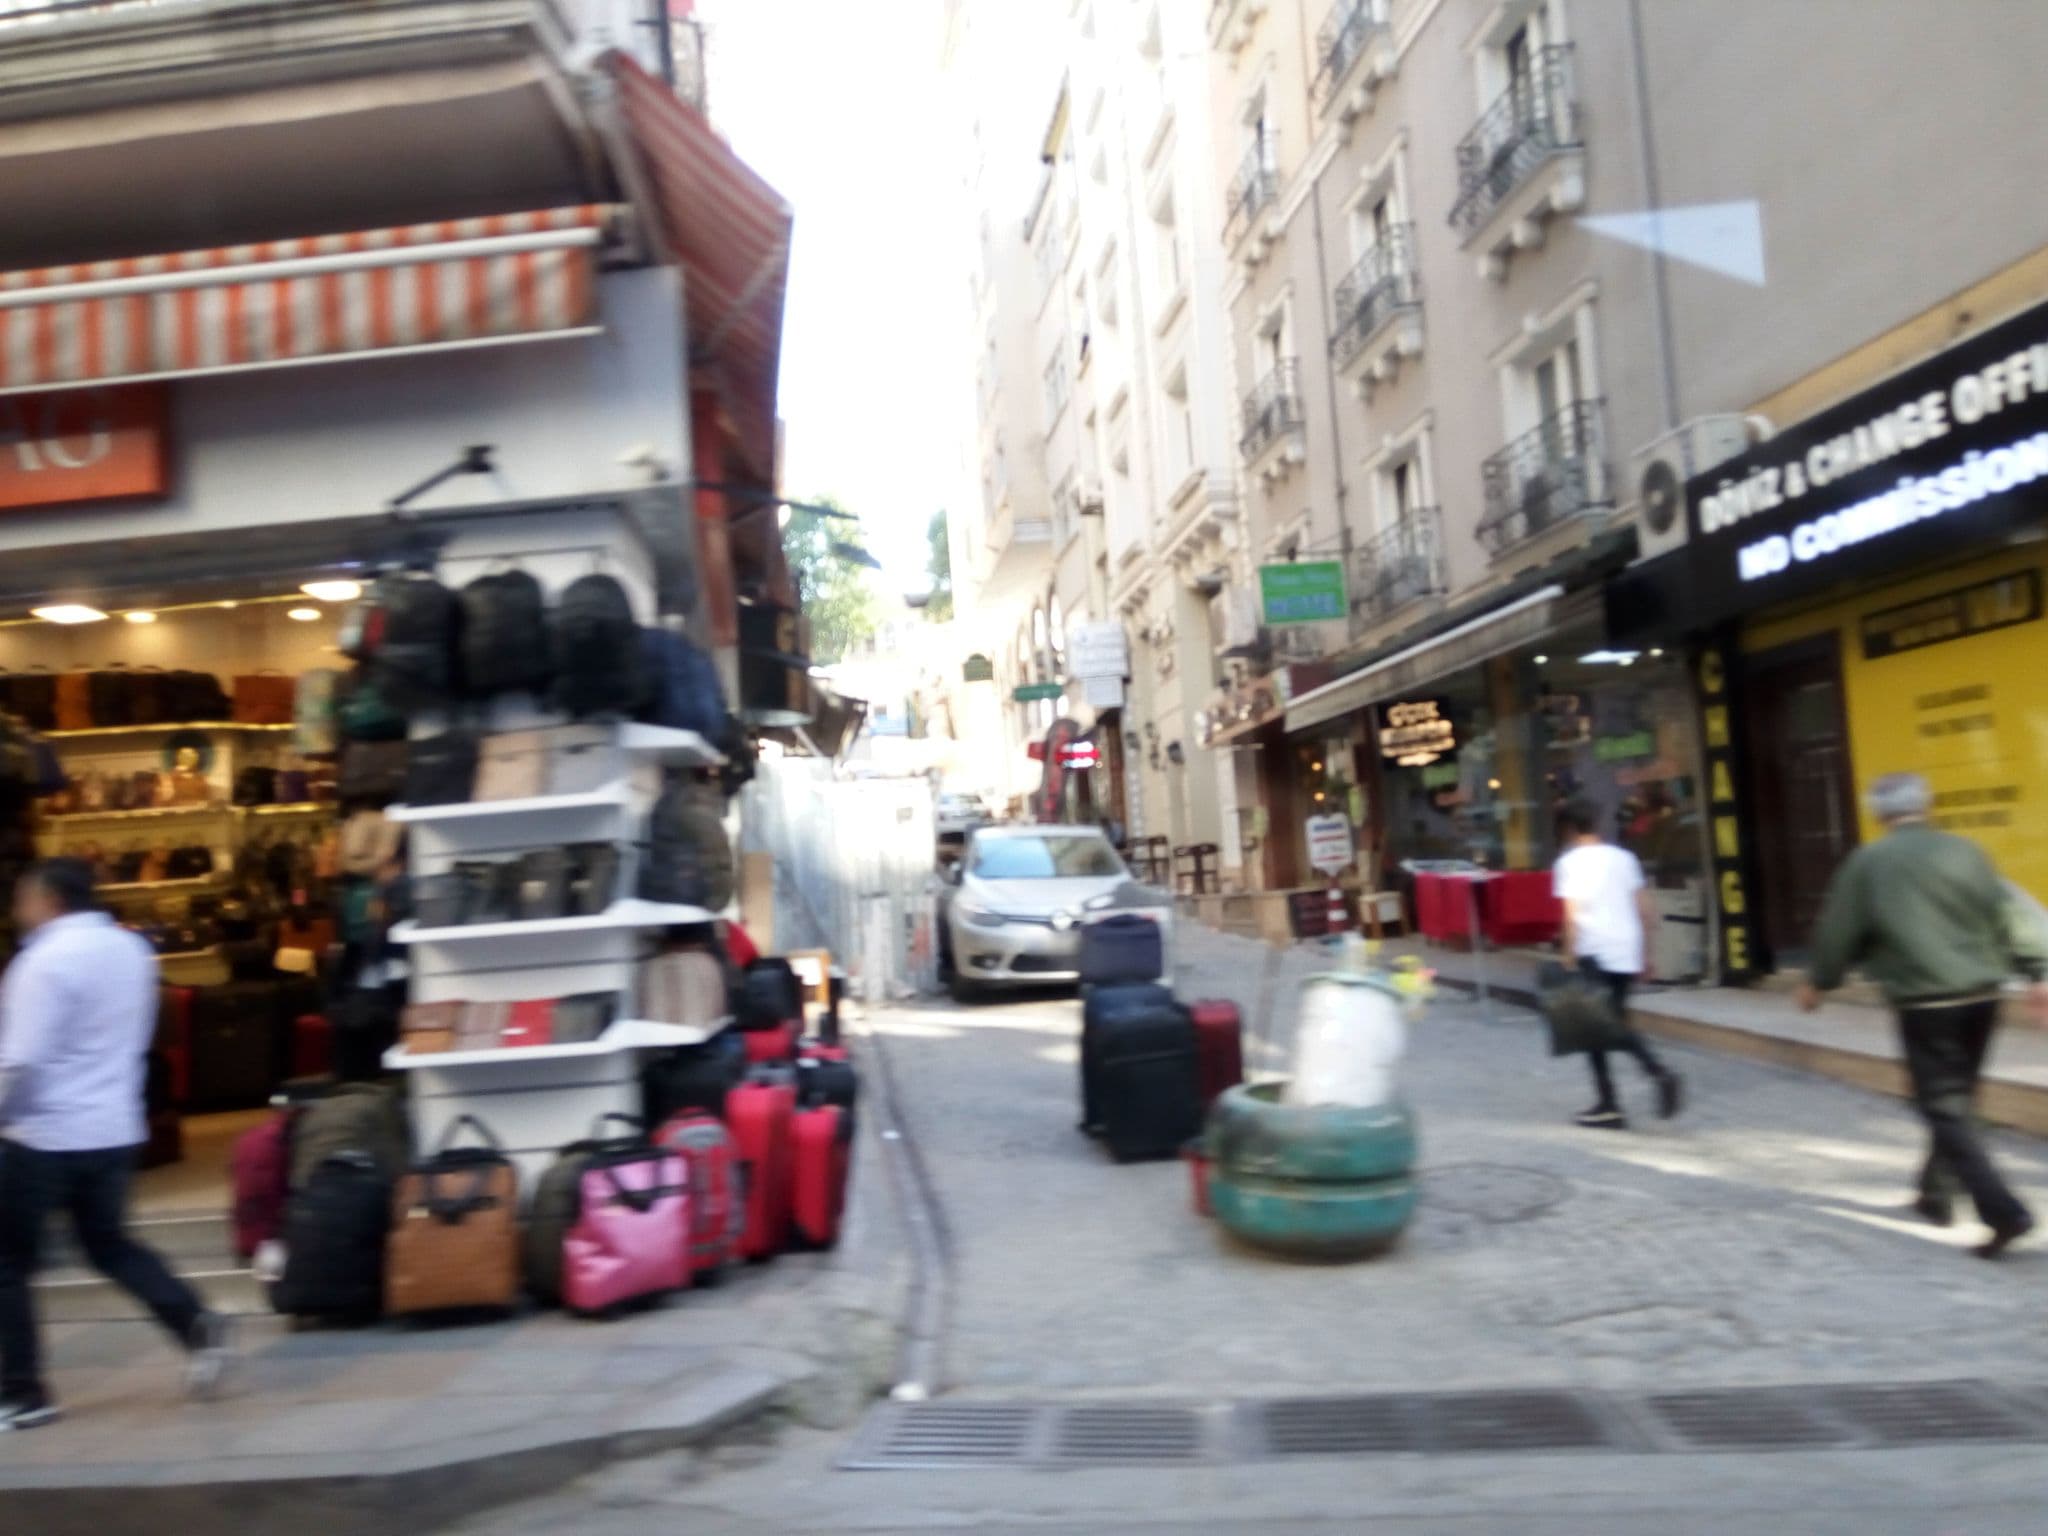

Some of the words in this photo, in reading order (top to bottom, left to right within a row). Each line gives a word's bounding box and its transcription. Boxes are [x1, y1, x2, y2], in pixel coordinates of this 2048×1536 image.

[1807, 391, 1950, 487] CHANGE
[1738, 535, 1791, 581] NO
[1702, 649, 1750, 970] CHANGE
